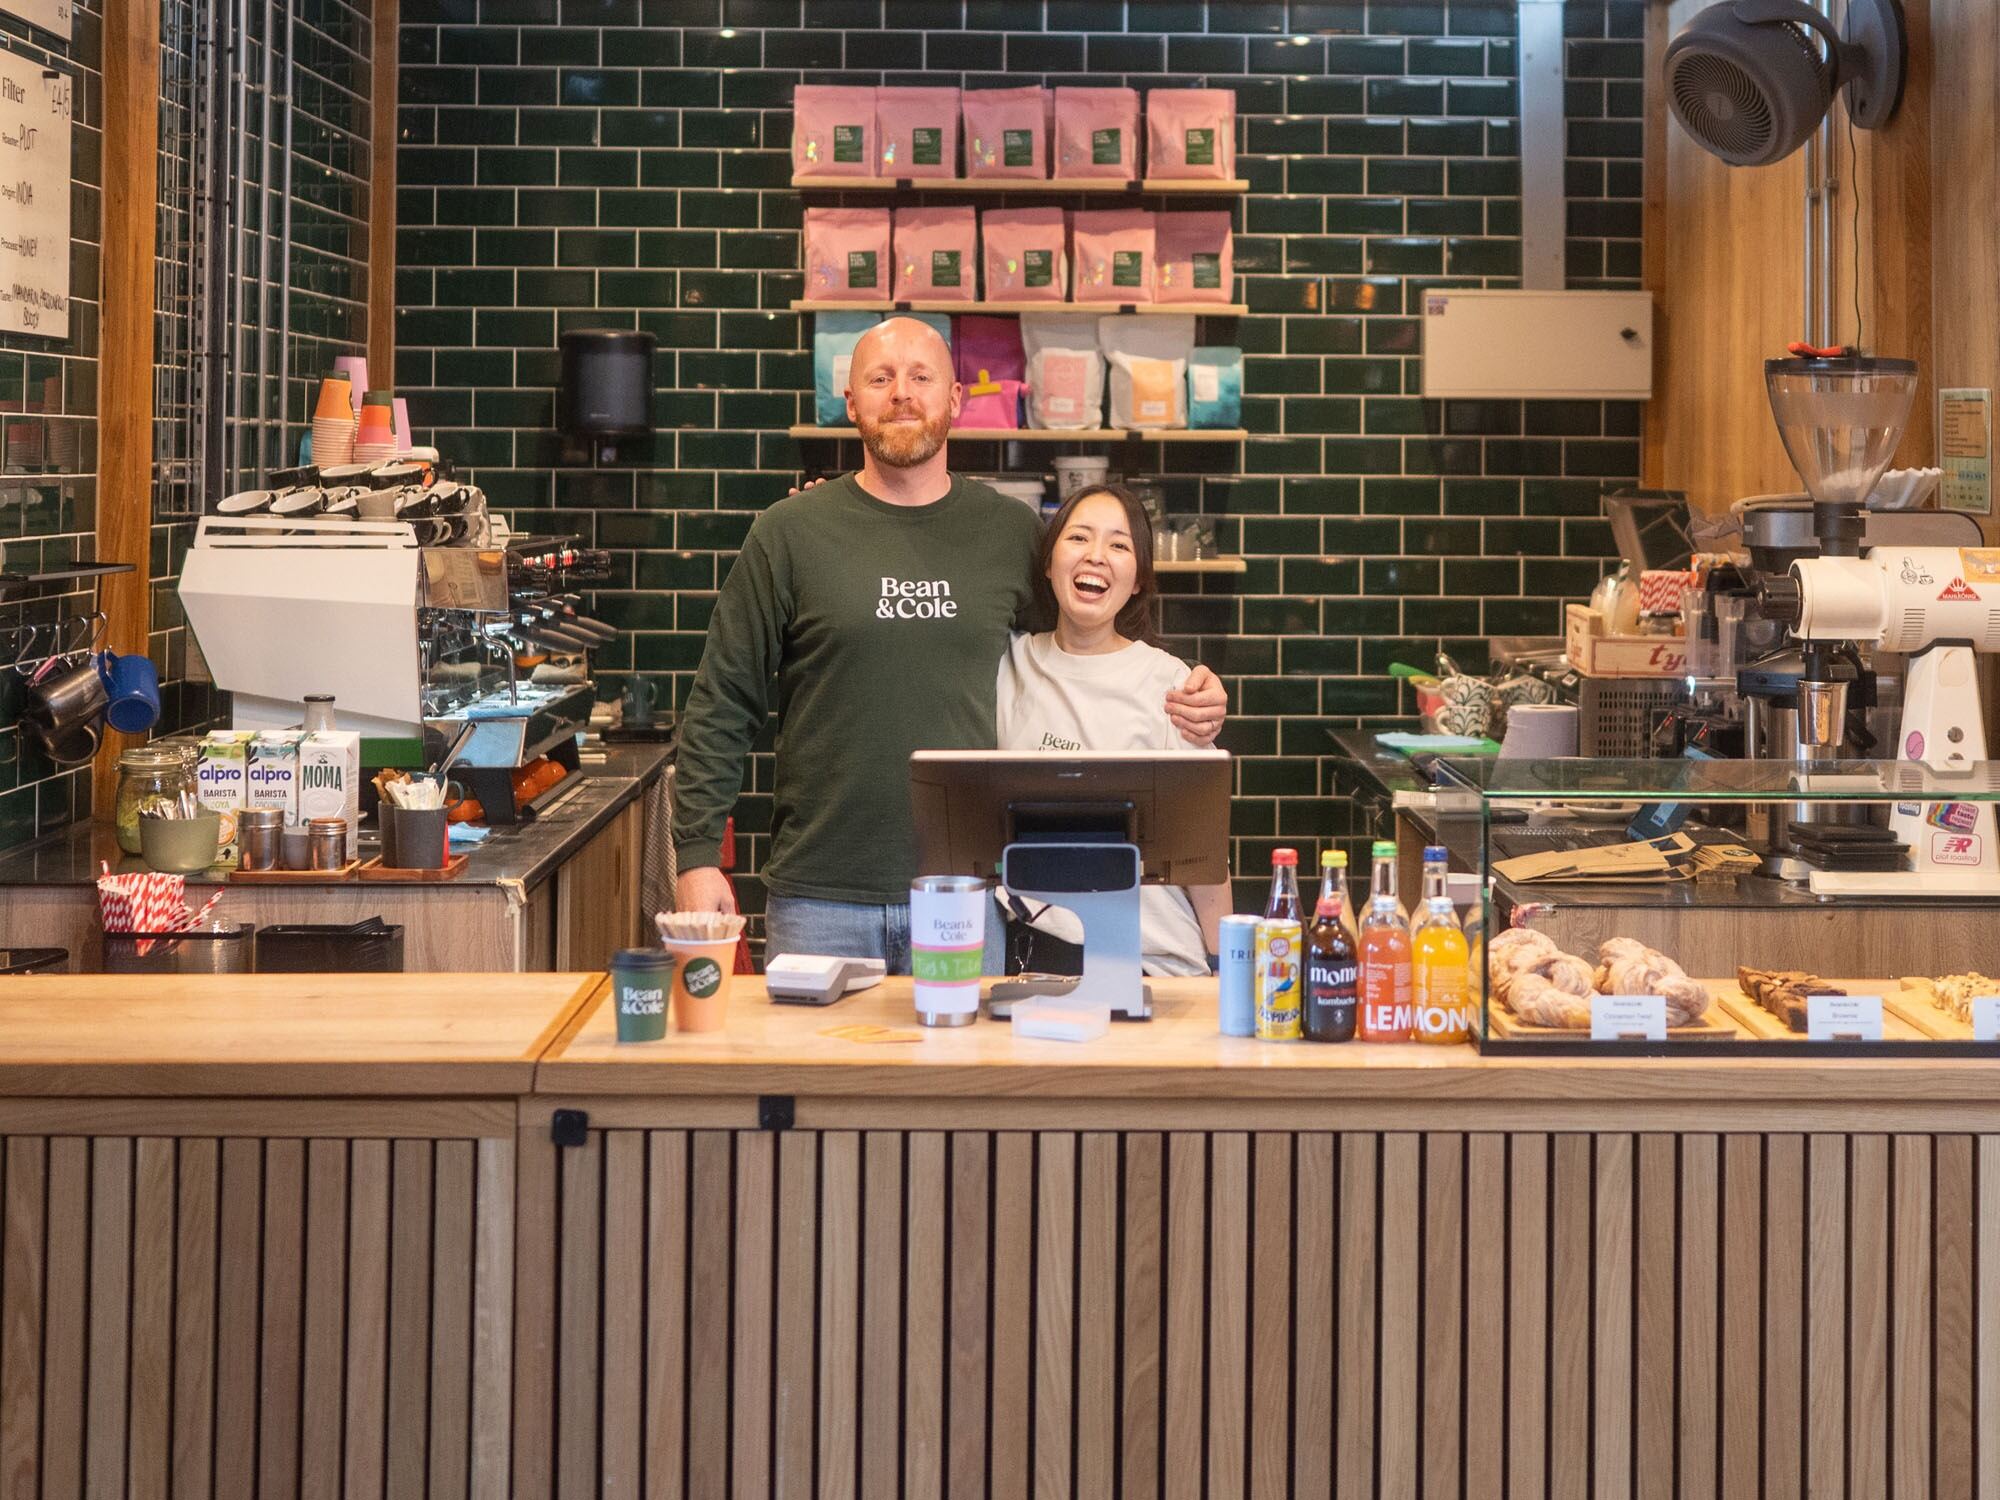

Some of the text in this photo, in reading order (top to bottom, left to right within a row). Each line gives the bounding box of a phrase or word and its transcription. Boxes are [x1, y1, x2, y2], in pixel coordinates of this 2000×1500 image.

[2, 77, 25, 104] Filter
[881, 577, 951, 597] Bean
[875, 598, 957, 619] &Cole
[1041, 731, 1081, 751] Bean
[200, 765, 241, 784] alpro
[251, 765, 292, 784] alpro
[303, 765, 342, 791] MOMA
[204, 789, 237, 798] BARISTA
[254, 790, 287, 799] BARISTA
[1957, 810, 1975, 820] taste
[940, 930, 967, 941] Cole
[623, 987, 663, 1002] Bean
[621, 1000, 665, 1015] &Cole
